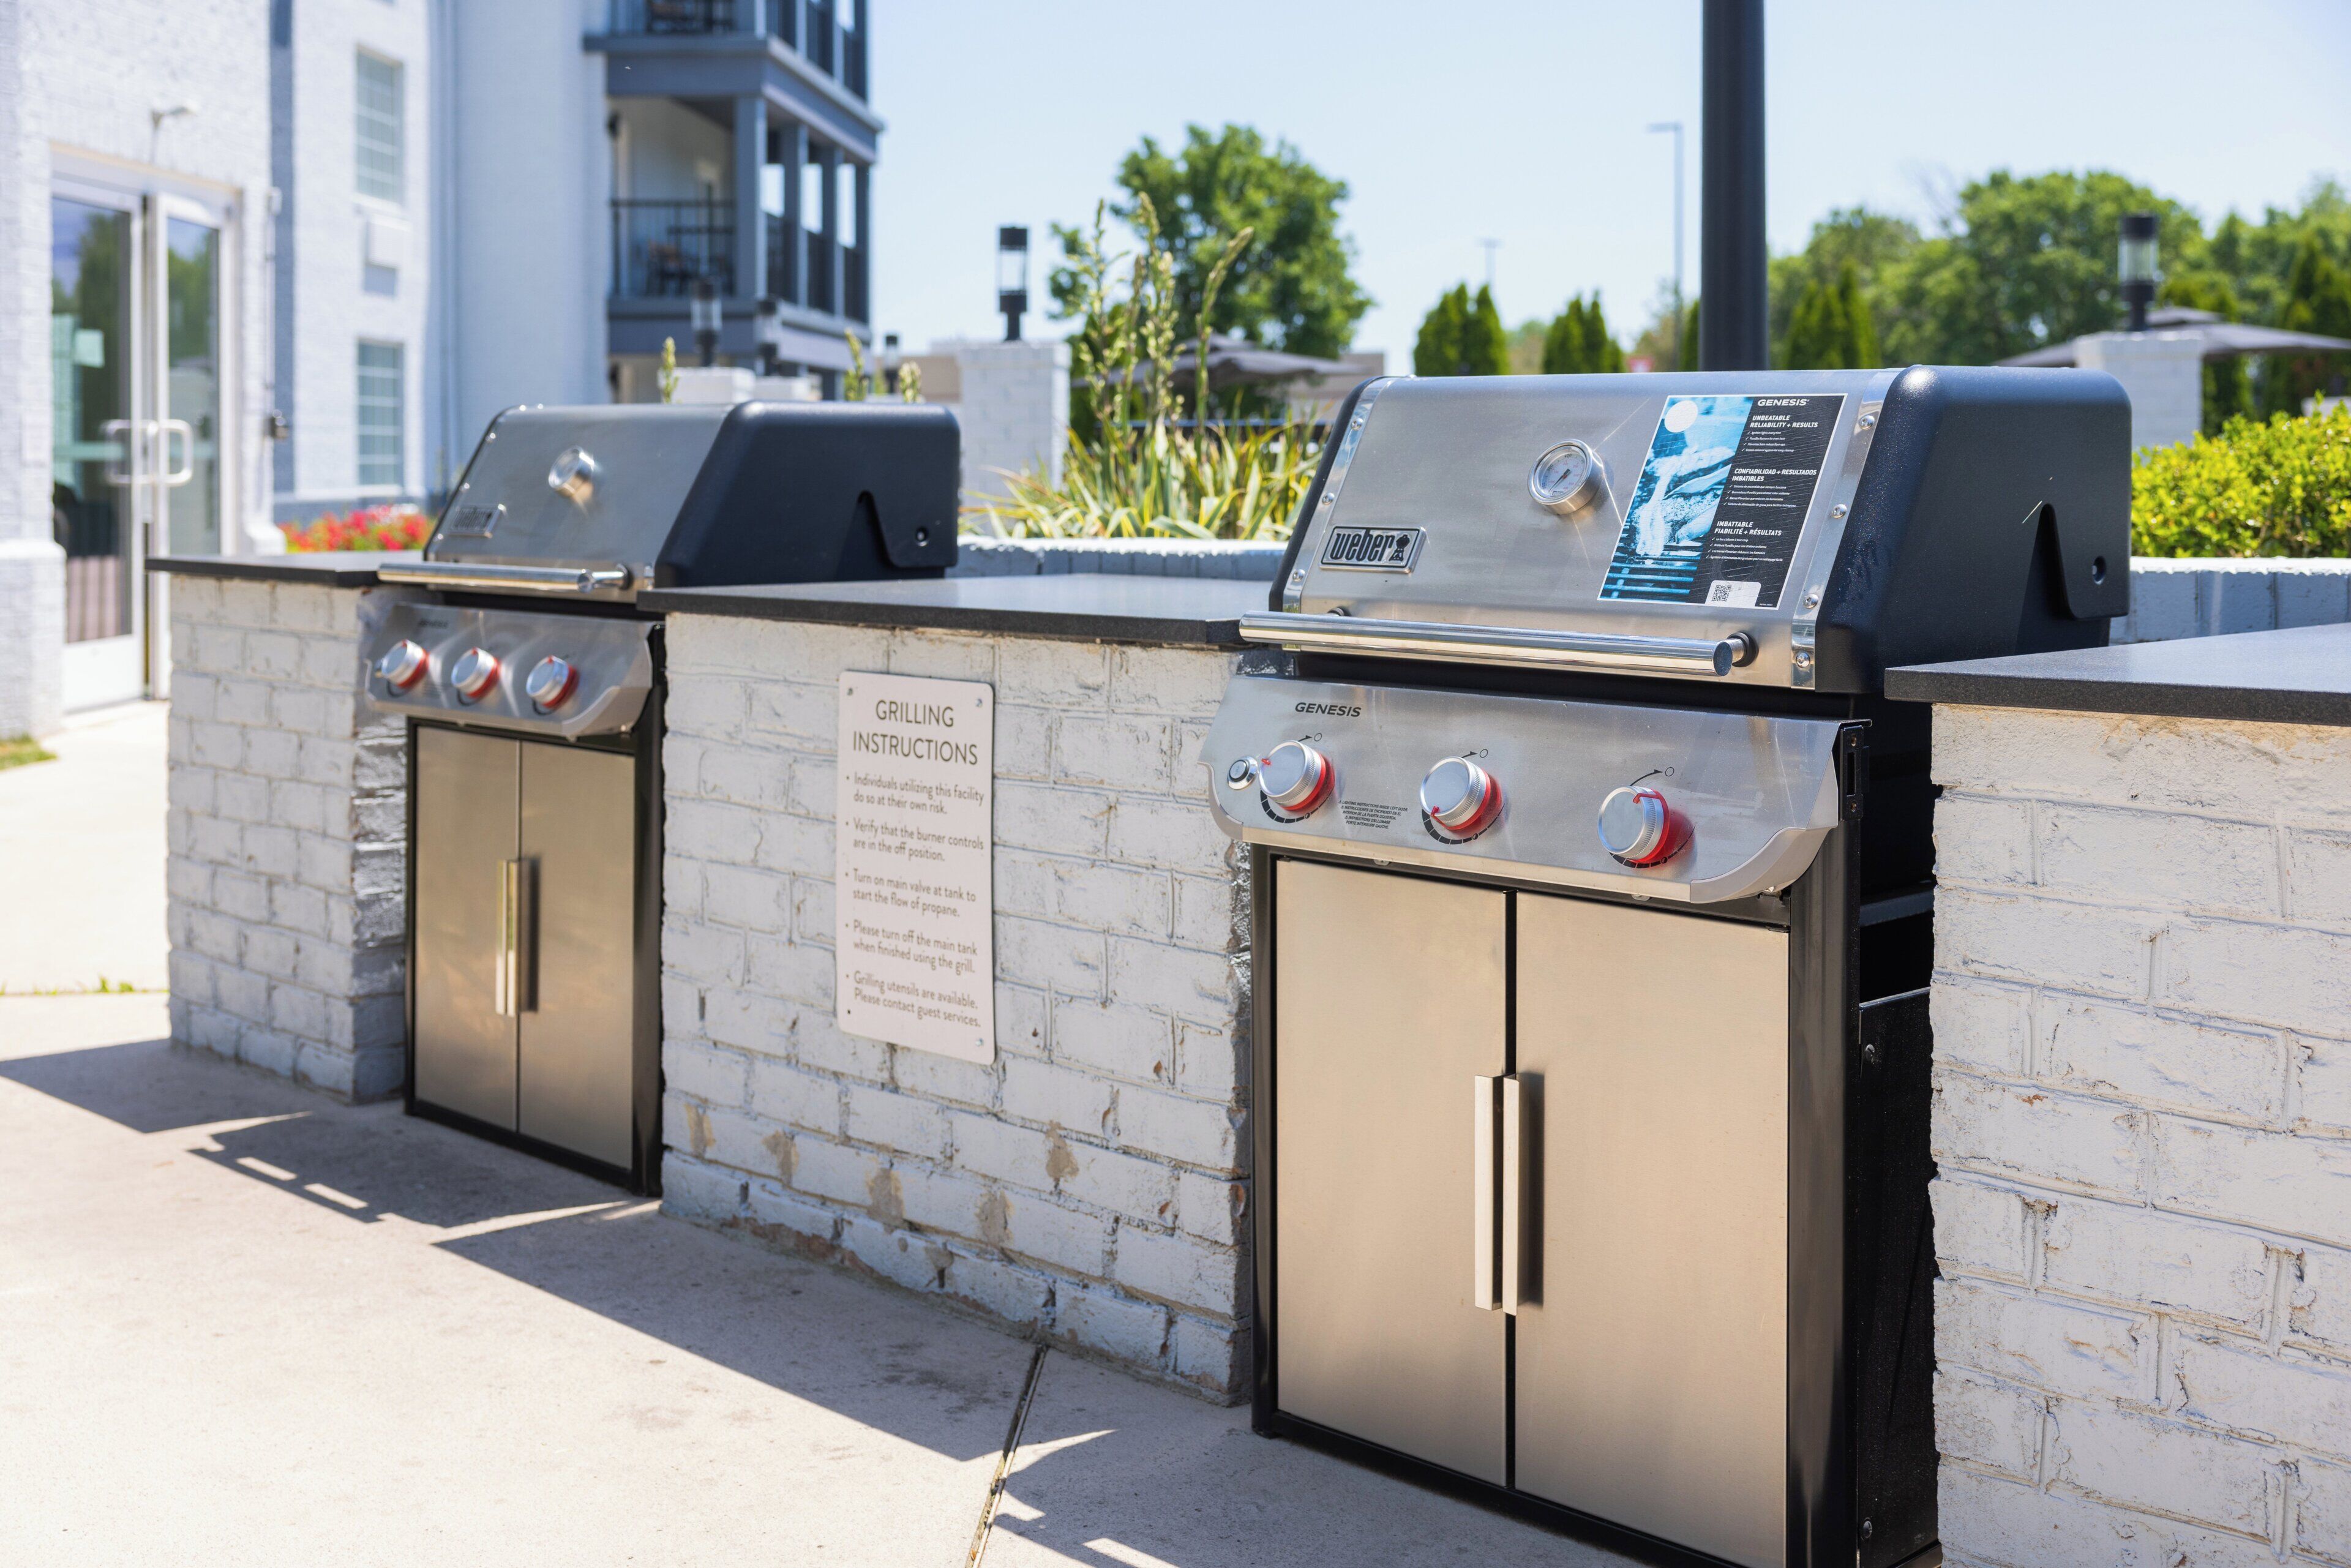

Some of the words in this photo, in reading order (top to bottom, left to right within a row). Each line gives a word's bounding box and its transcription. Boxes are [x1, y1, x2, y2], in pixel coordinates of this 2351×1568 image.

[1330, 529, 1395, 561] weber
[876, 700, 954, 727] GRILLING
[1295, 702, 1362, 718] GENESIS
[853, 731, 978, 765] INSTRUCTIONS
[854, 772, 897, 790] Individuals
[899, 779, 933, 800] utilizing
[936, 782, 951, 796] this
[954, 784, 984, 806] facility
[854, 789, 864, 802] do
[877, 795, 885, 806] at
[888, 794, 907, 808] their
[910, 801, 927, 811] own
[929, 798, 947, 814] risk.
[853, 817, 879, 838] Verify
[881, 821, 898, 836] that
[901, 824, 914, 839] the
[917, 827, 945, 843] burner
[948, 836, 984, 850] controls
[853, 839, 866, 848] are
[868, 836, 876, 850] in
[879, 839, 892, 853] the
[894, 841, 907, 855] off
[909, 844, 945, 861] position.
[853, 868, 872, 883] Turn
[874, 876, 885, 886] on
[887, 876, 907, 889] main
[910, 880, 931, 895] valve
[933, 886, 942, 896] at
[944, 886, 964, 900] tank
[966, 891, 976, 902] to
[853, 889, 872, 902] start
[875, 890, 891, 904] the
[891, 892, 908, 907] flow
[910, 896, 920, 909] of
[922, 902, 960, 918] propane.
[853, 919, 880, 937] Please
[882, 928, 900, 940] turn
[902, 929, 915, 943] off
[917, 932, 931, 947] the
[934, 937, 955, 951] main
[958, 942, 978, 956] tank
[853, 939, 876, 953] when
[878, 940, 911, 961] finished
[913, 950, 936, 971] using
[939, 954, 953, 969] the
[955, 956, 975, 975] grill.
[853, 970, 885, 995] Grilling
[888, 980, 919, 997] utensils
[921, 989, 935, 1000] are
[937, 990, 978, 1009] available.
[854, 987, 880, 1005] Please
[882, 997, 915, 1013] contact
[917, 1005, 941, 1020] guest
[943, 1010, 981, 1027] services.
